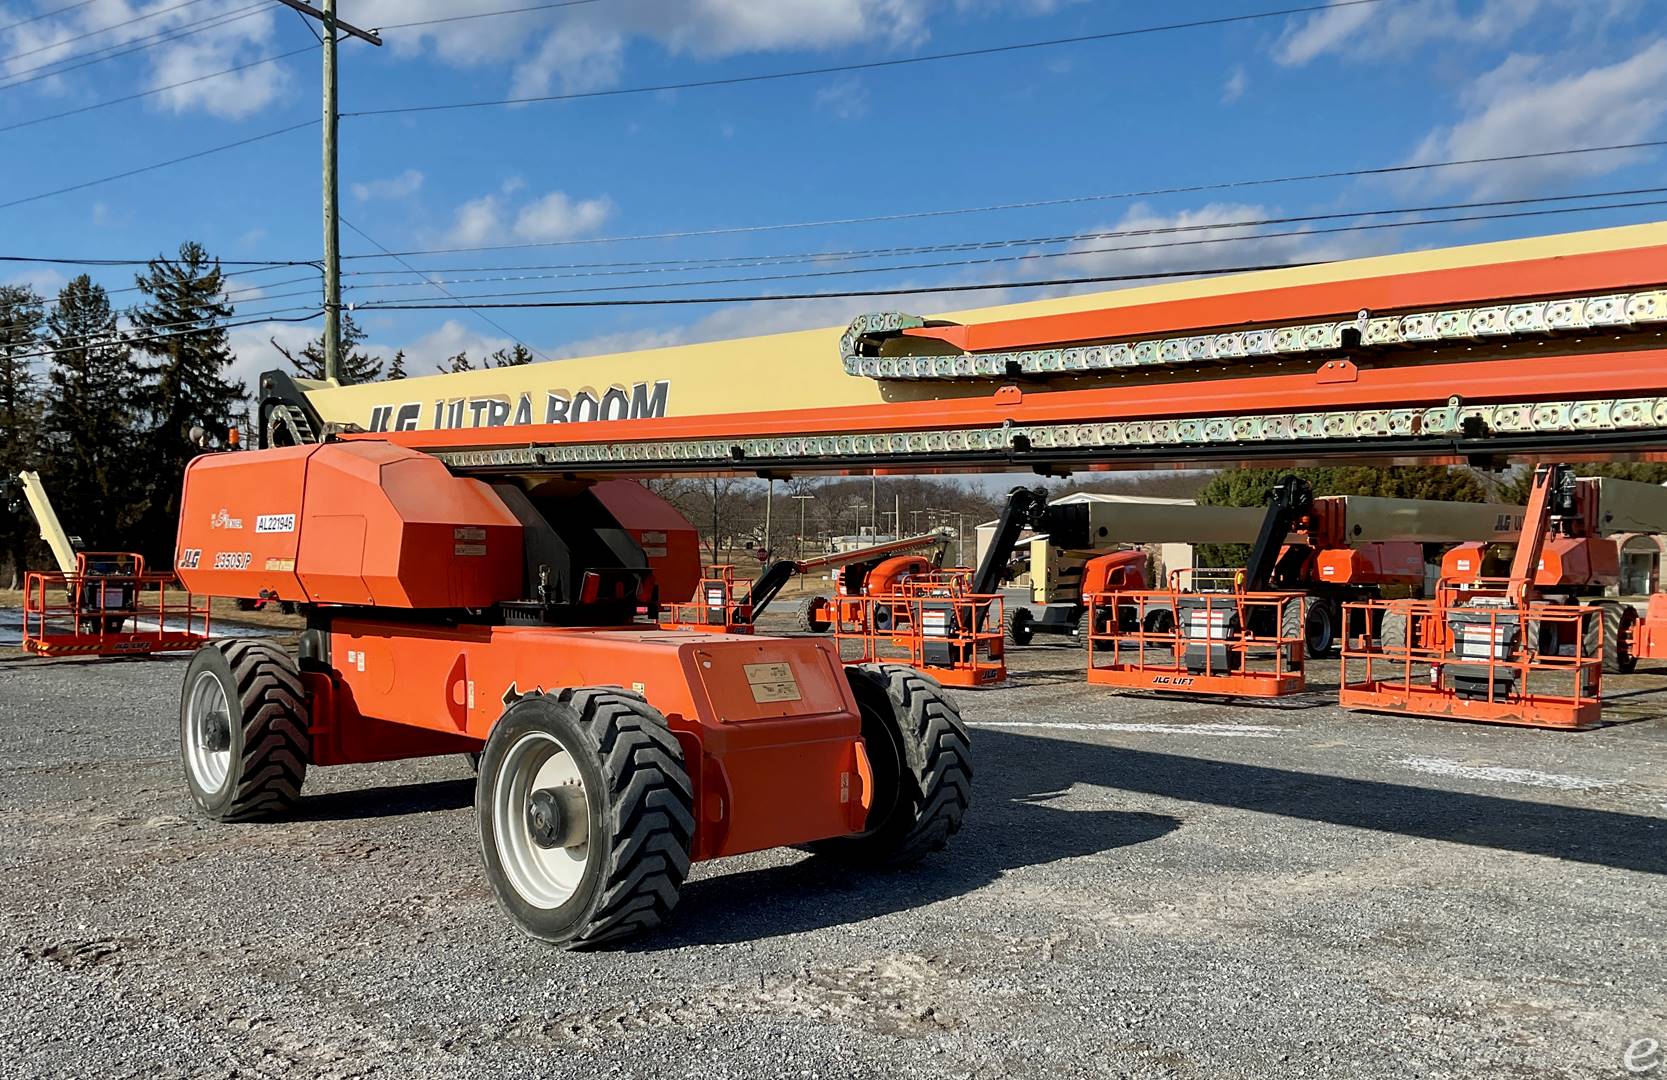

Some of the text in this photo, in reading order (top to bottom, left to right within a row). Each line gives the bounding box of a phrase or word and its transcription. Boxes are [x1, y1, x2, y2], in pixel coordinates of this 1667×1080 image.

[434, 391, 532, 430] ULTRA
[545, 380, 671, 425] BOOM
[258, 515, 294, 531] AL221946
[179, 549, 202, 569] JLG
[214, 552, 252, 570] 1350SJP
[1152, 675, 1195, 686] JLG LIFT
